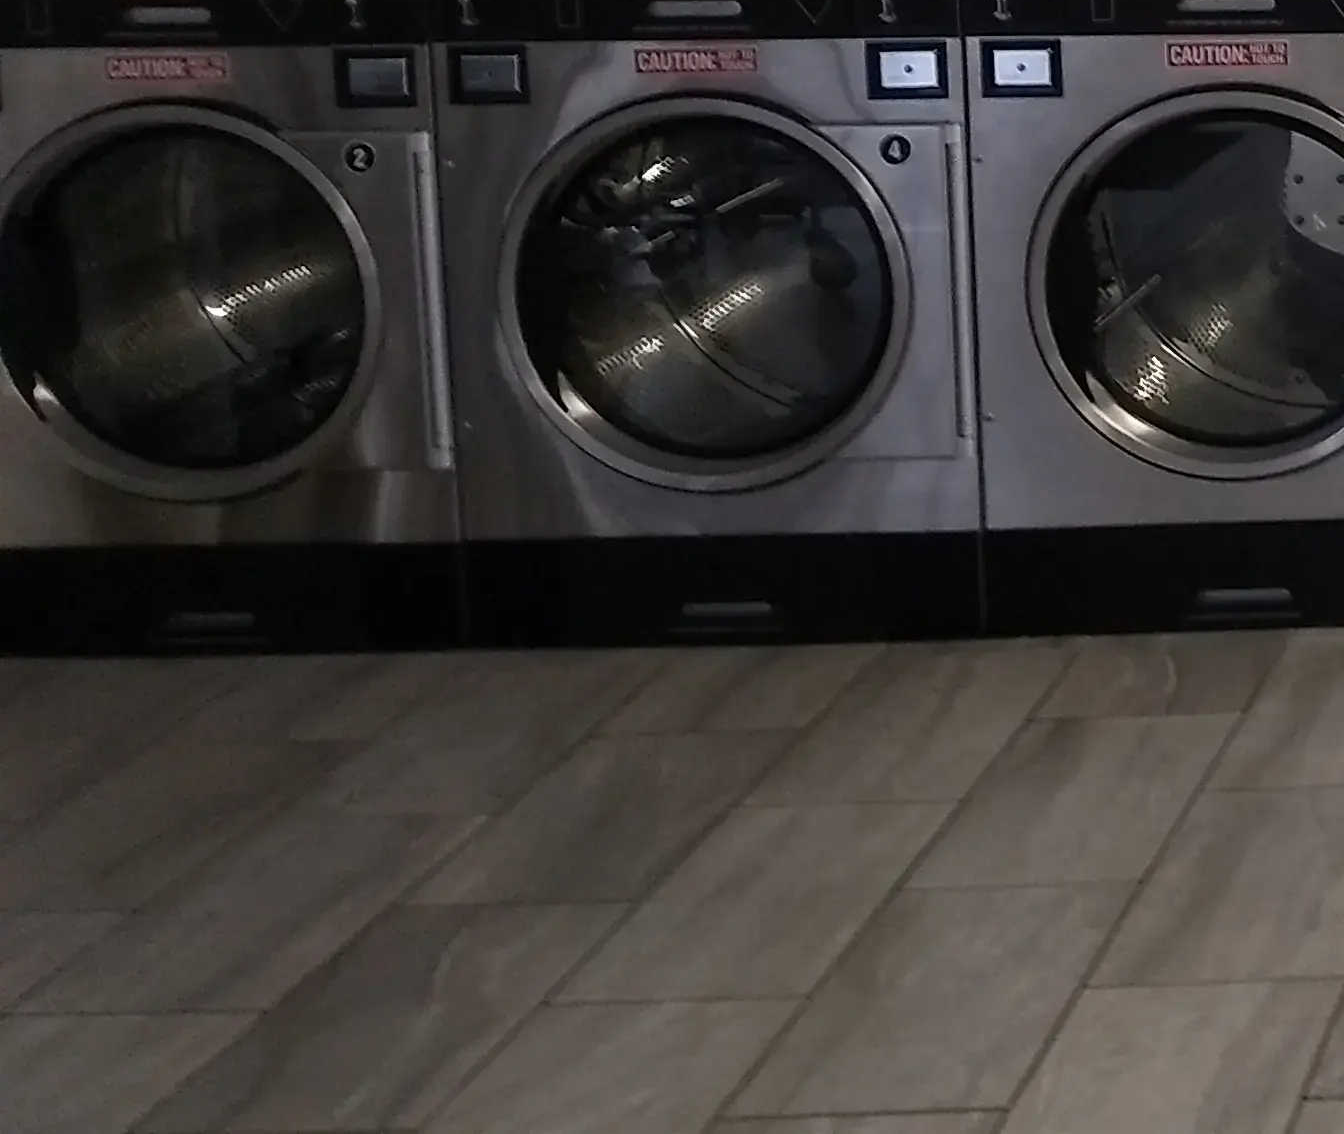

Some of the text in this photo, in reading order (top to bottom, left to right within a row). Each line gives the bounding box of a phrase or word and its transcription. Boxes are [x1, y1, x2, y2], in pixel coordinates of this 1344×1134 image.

[638, 51, 717, 71] CAUTION:
[1170, 45, 1249, 65] CAUTION:
[353, 149, 367, 168] 2
[888, 140, 902, 159] 4
